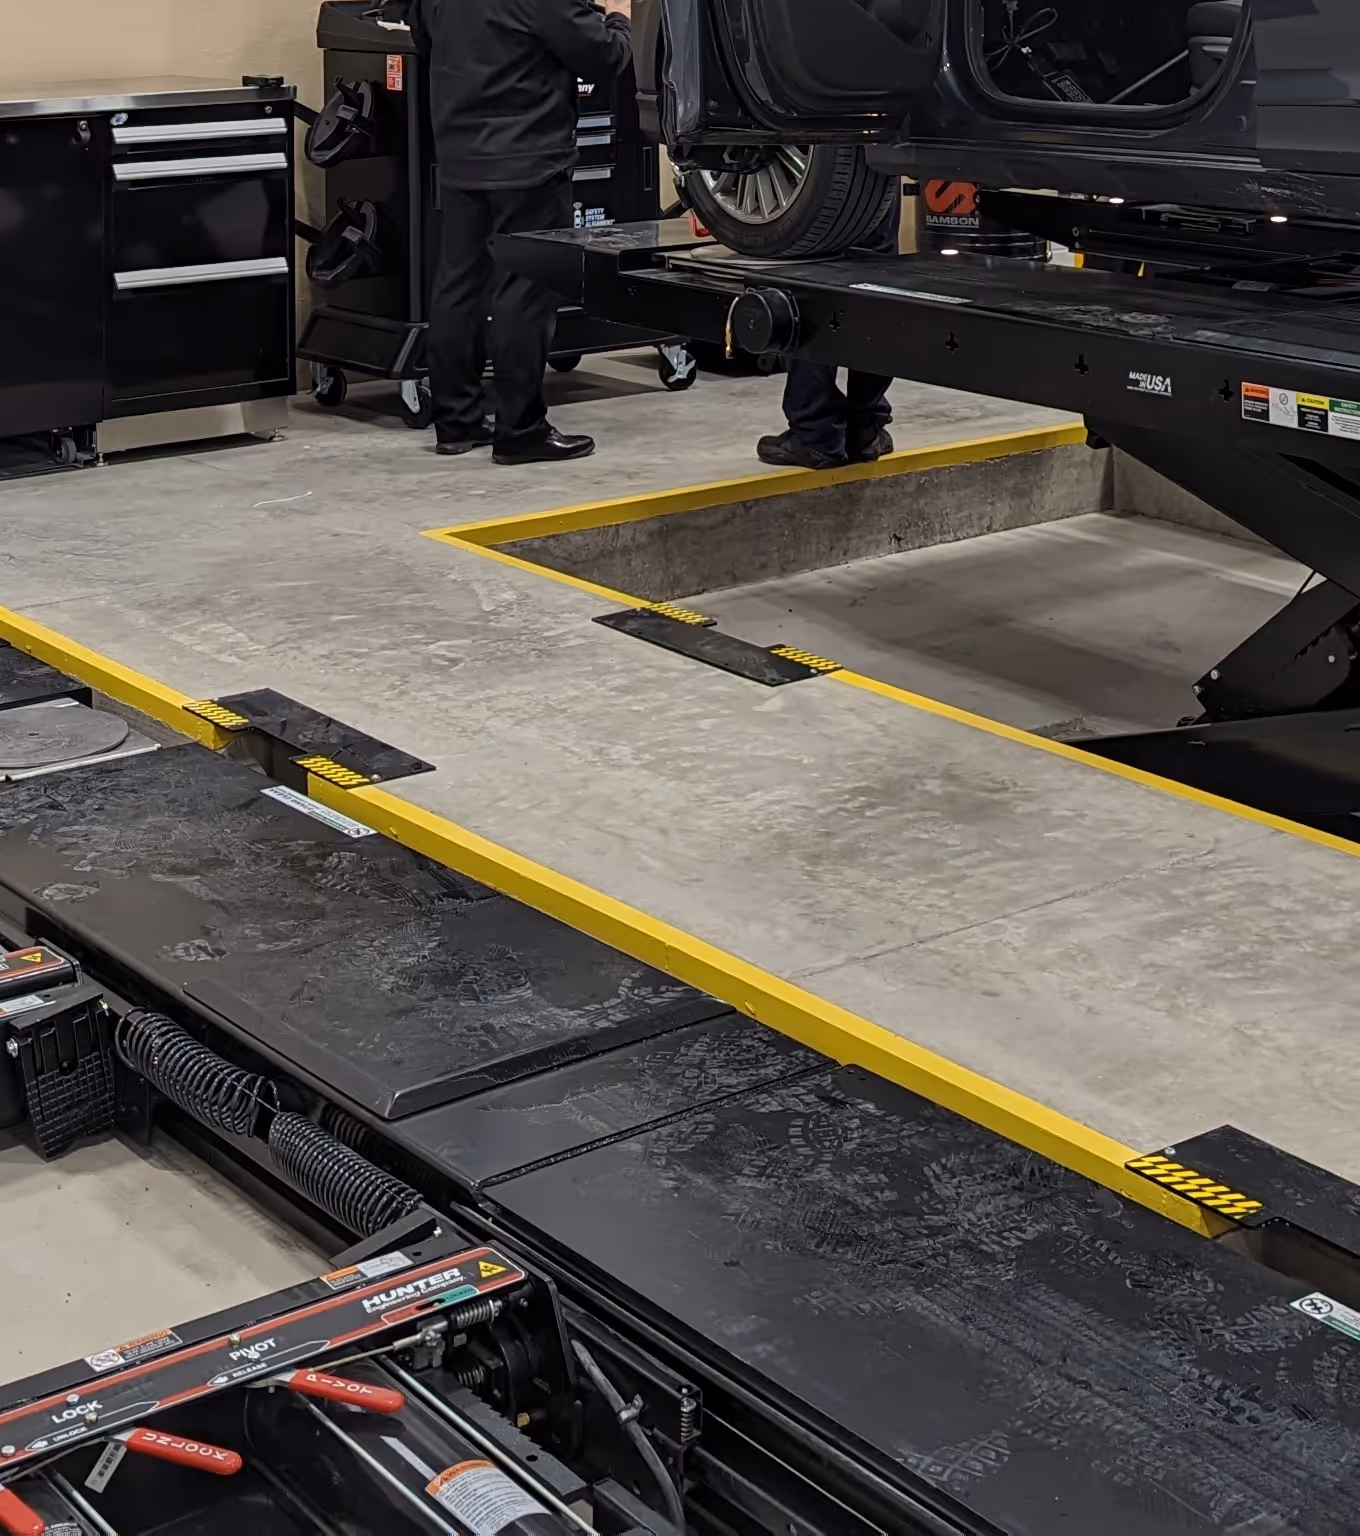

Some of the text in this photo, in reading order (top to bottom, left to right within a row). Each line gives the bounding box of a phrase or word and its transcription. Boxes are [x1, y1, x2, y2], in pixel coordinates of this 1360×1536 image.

[926, 215, 980, 226] SAMSON
[1147, 374, 1172, 393] USA
[362, 1267, 461, 1309] HUNTER
[366, 1290, 421, 1313] Engineering
[228, 1337, 277, 1362] PIVOT
[232, 1362, 268, 1378] RELEASE
[305, 1374, 373, 1394] PIVOT
[51, 1399, 104, 1424] LOCK
[142, 1431, 229, 1461] UNLOCK
